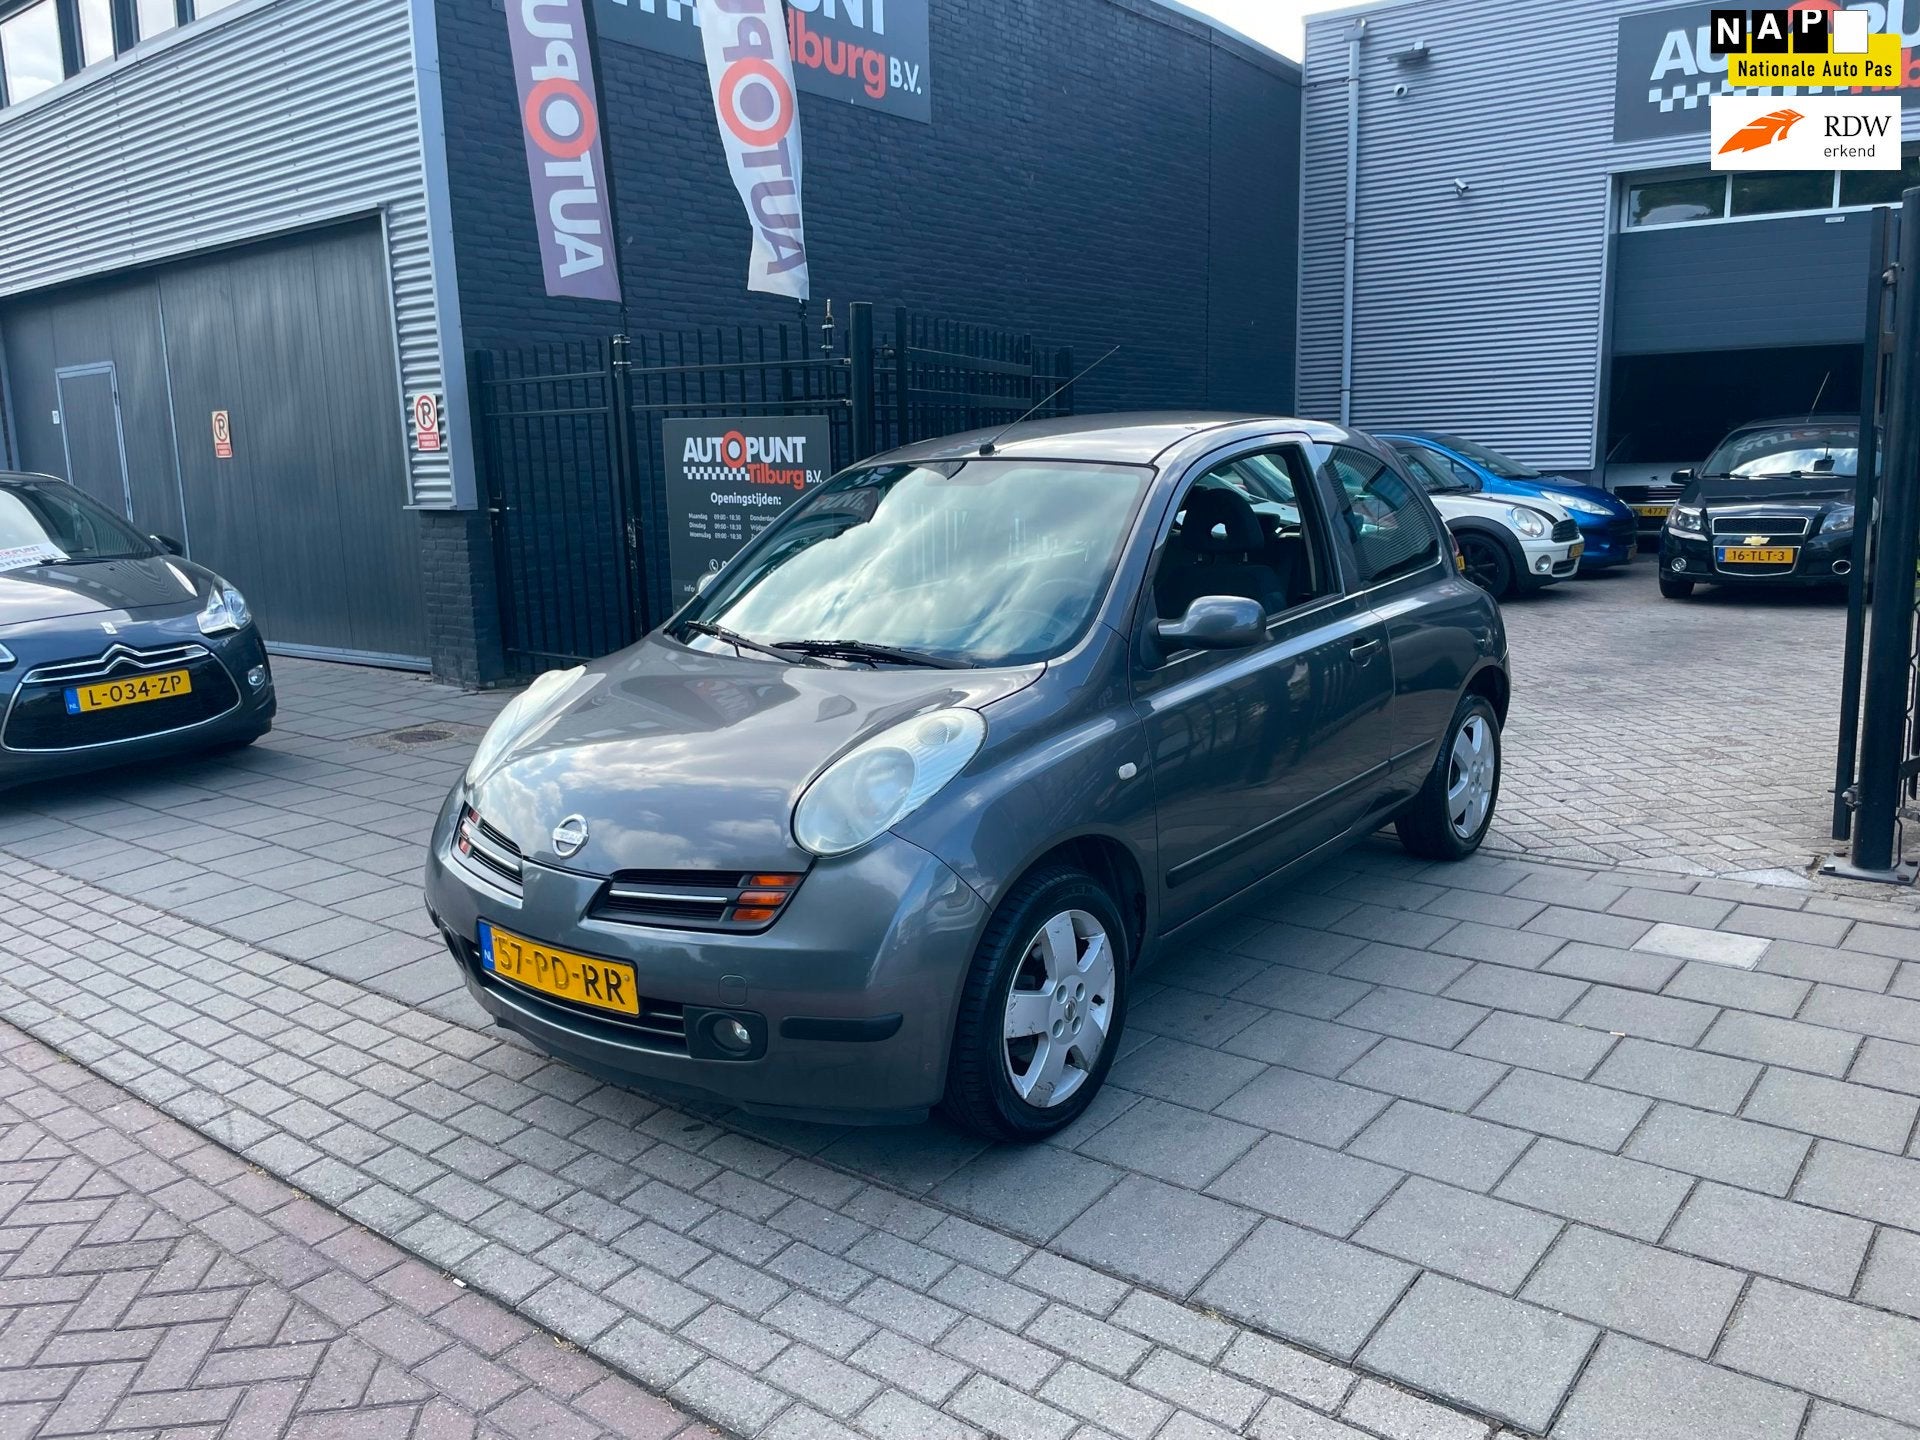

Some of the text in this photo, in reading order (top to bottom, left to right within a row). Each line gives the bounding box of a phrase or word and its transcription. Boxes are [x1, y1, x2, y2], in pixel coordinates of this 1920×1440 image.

[788, 7, 886, 99] lburg
[889, 56, 922, 95] B.V.
[682, 430, 807, 469] AUTOPUNT
[747, 464, 823, 491] Tilburg B.V.
[711, 492, 782, 507] Openingstijden:
[1732, 550, 1785, 561] 16-TLT-3
[88, 675, 181, 707] L-034-ZP
[484, 936, 626, 1005] NL 57-PD-RR
